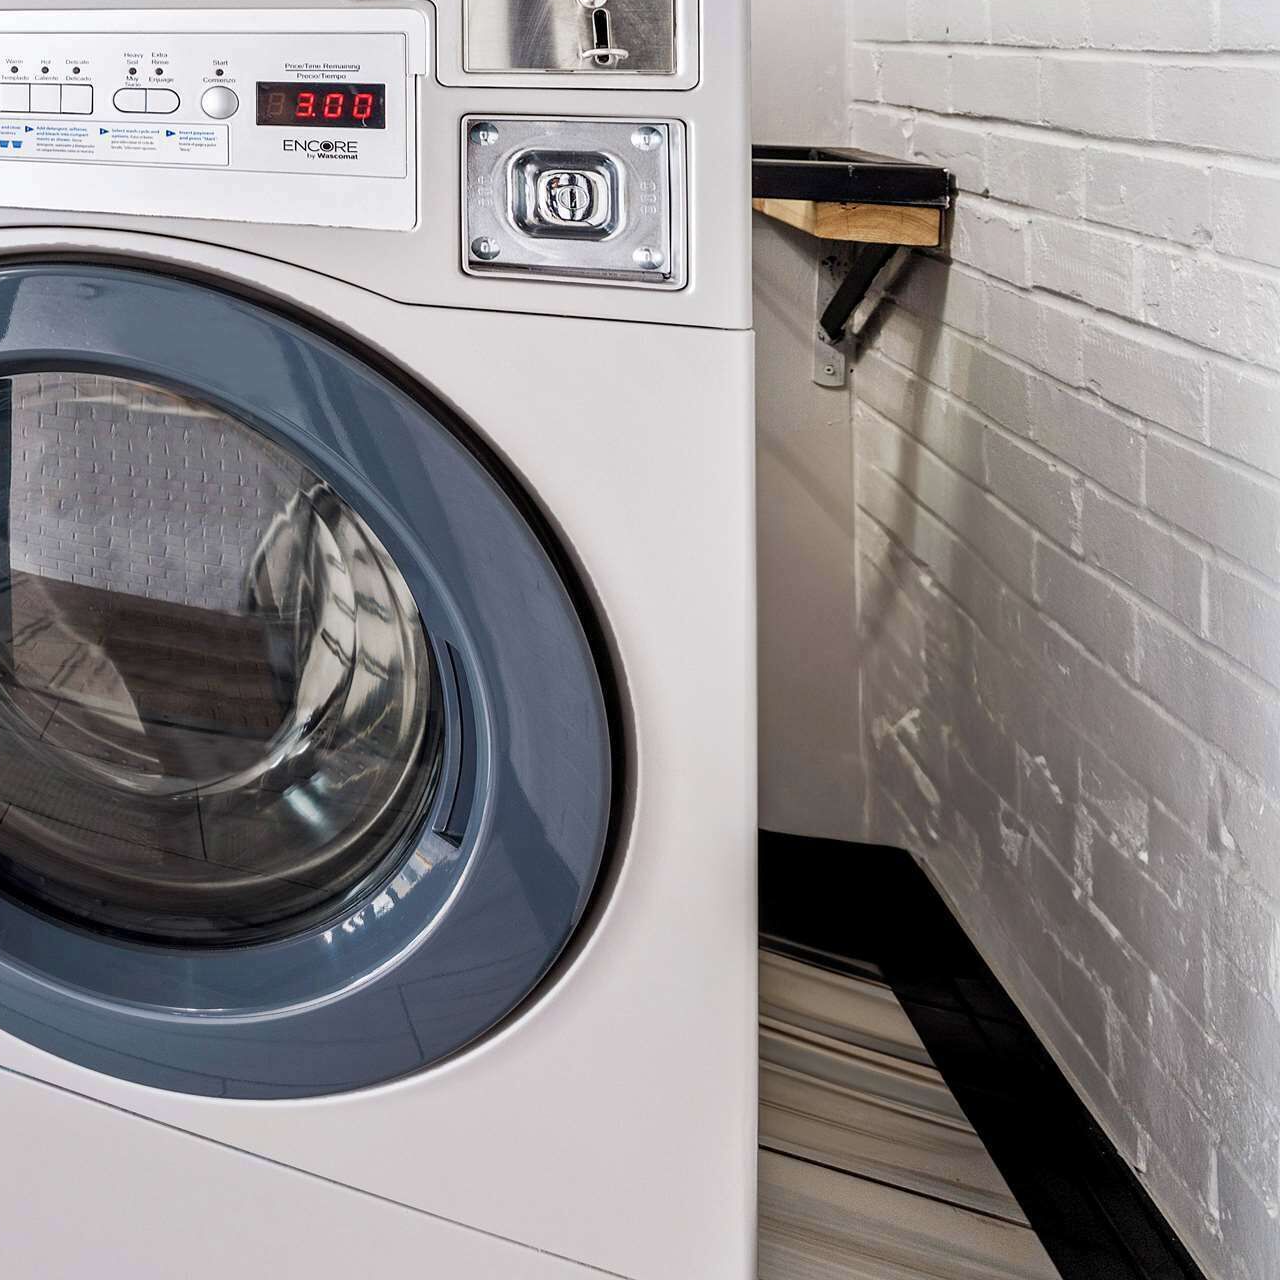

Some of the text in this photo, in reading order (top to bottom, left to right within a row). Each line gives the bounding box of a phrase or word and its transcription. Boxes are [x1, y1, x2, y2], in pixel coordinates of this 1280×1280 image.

[295, 92, 374, 119] 3.00
[282, 139, 359, 153] ENCORE
[306, 152, 359, 160] by Wascomat
